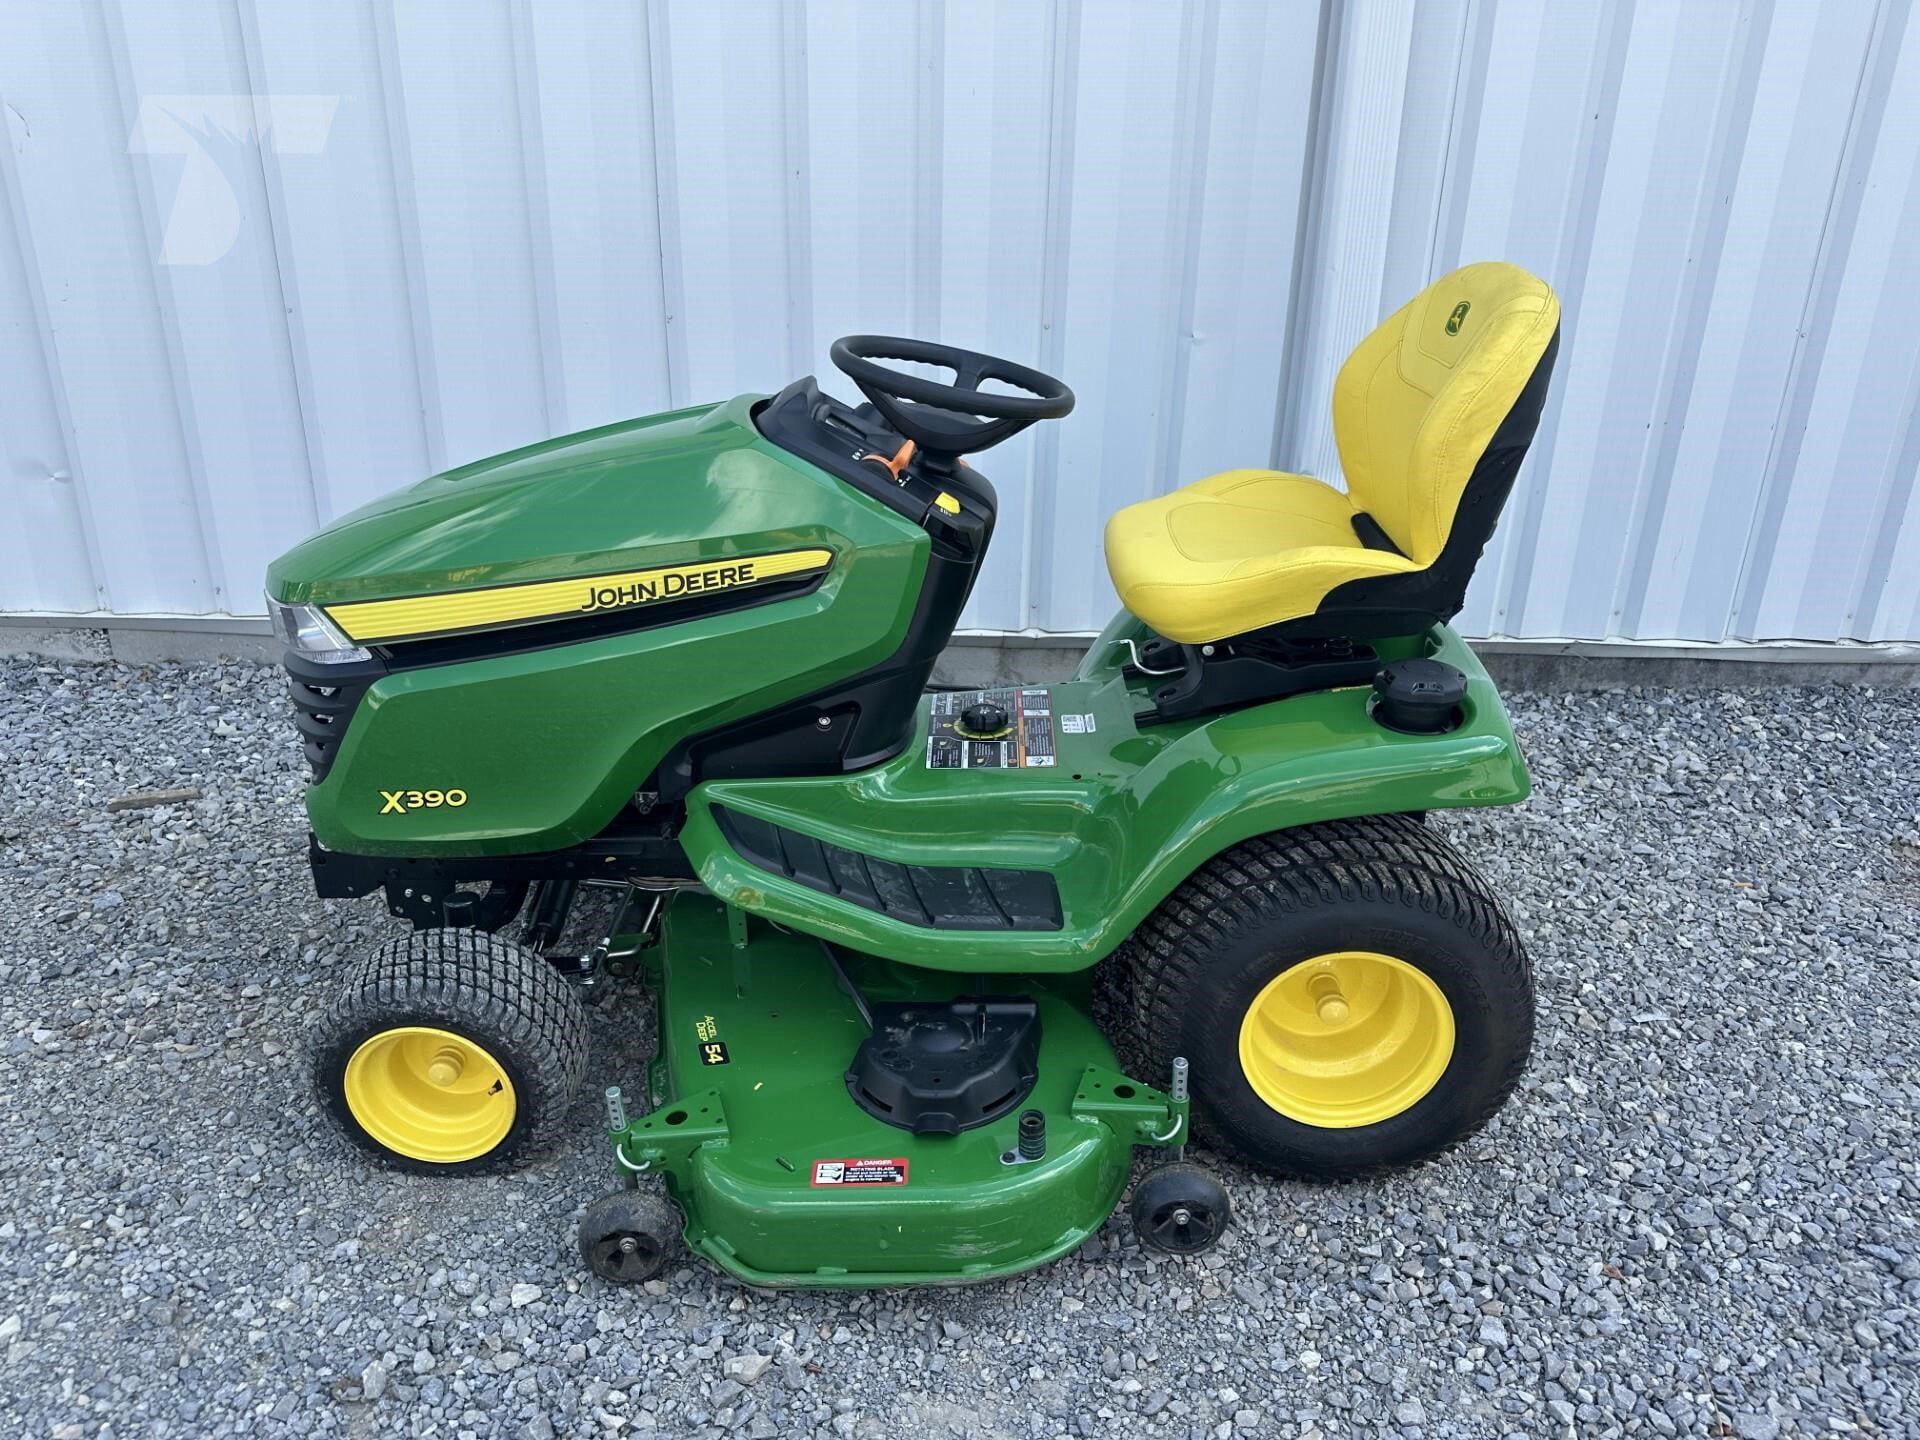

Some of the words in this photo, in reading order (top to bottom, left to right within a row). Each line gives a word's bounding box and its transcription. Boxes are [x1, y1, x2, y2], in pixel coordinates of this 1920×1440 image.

[582, 580, 657, 612] JOHN
[663, 563, 758, 596] DEERE
[379, 788, 468, 815] X390
[696, 1021, 709, 1042] DEEP
[704, 1015, 718, 1039] ACCEL
[705, 1044, 724, 1064] 54
